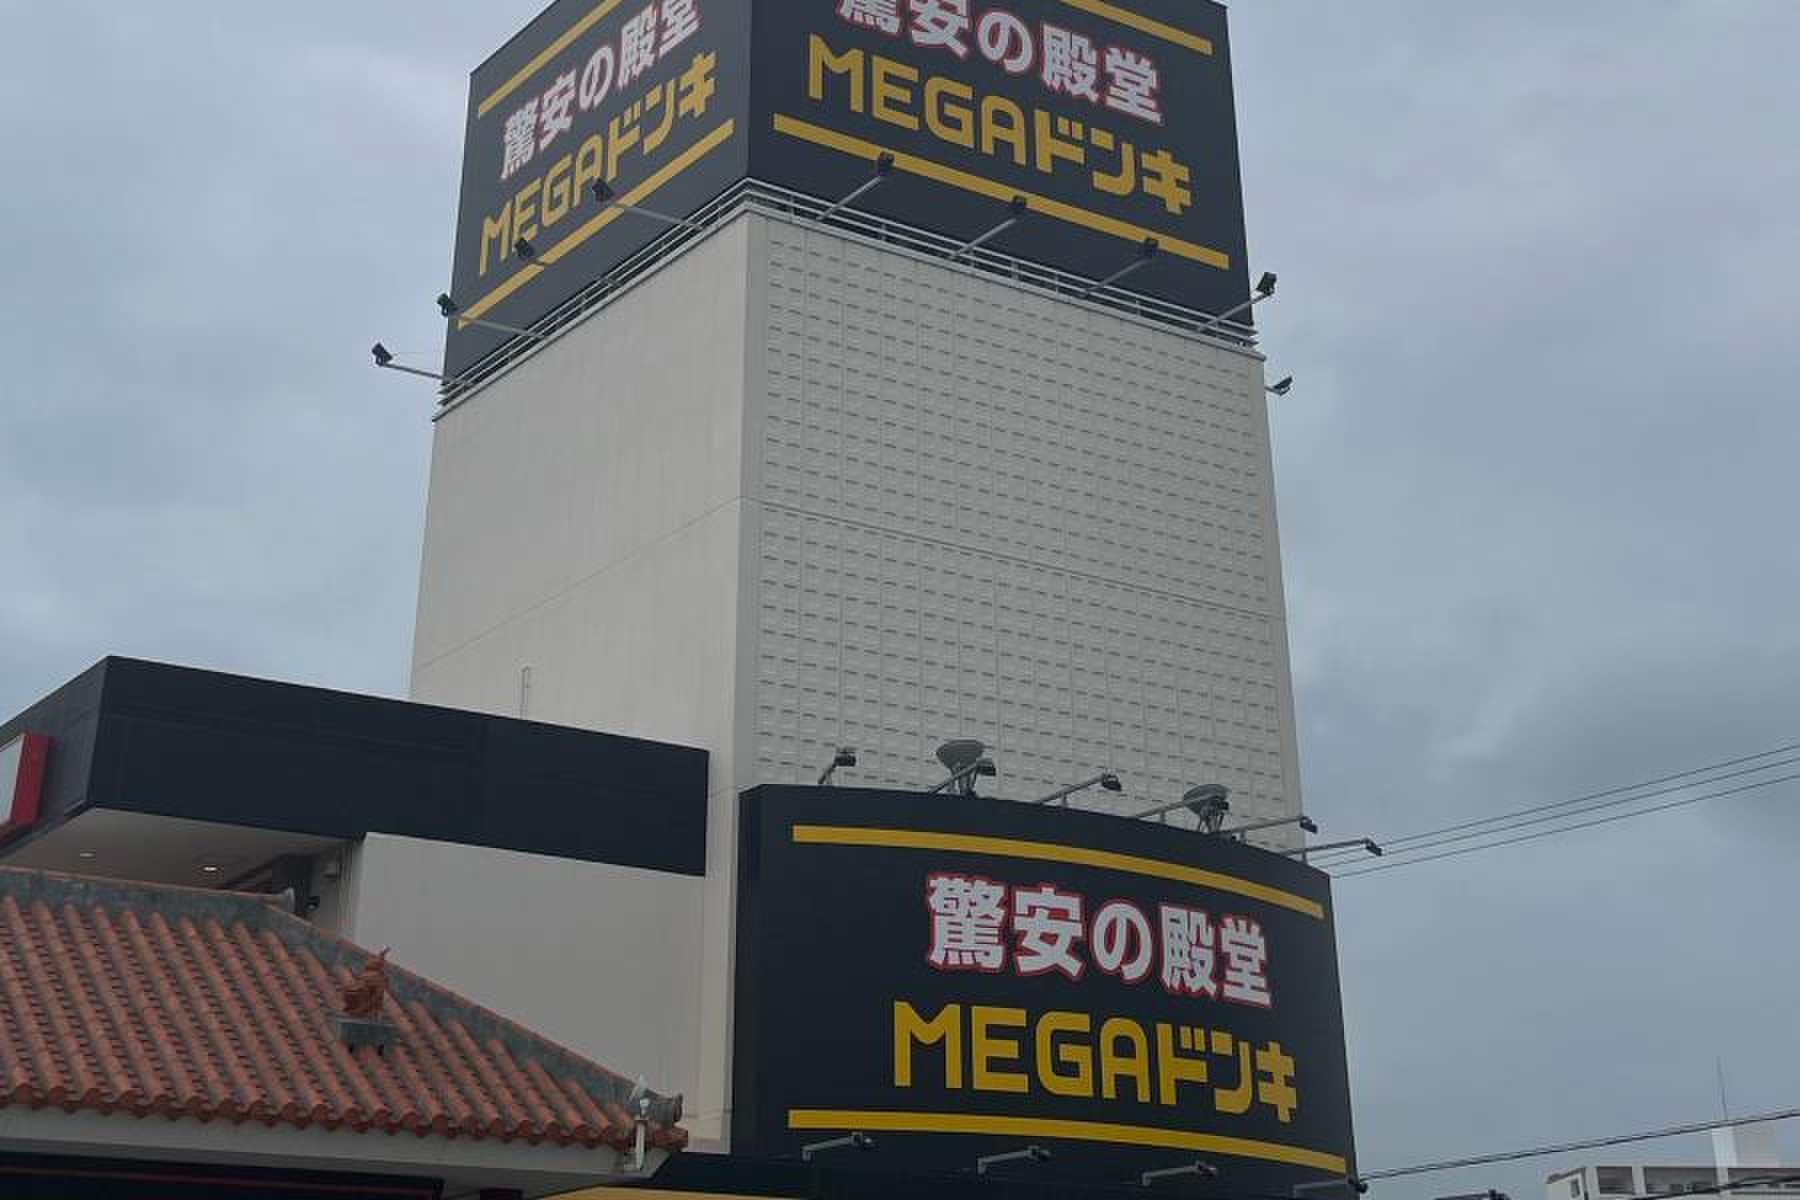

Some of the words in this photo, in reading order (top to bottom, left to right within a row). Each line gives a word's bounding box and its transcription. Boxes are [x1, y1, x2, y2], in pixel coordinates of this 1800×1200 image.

[479, 50, 716, 277] MEGAドンキ
[807, 33, 1192, 215] MEGAドンキ
[926, 870, 1273, 1008] 驚安の殿堂
[893, 1000, 1297, 1124] MEGAドンキ
